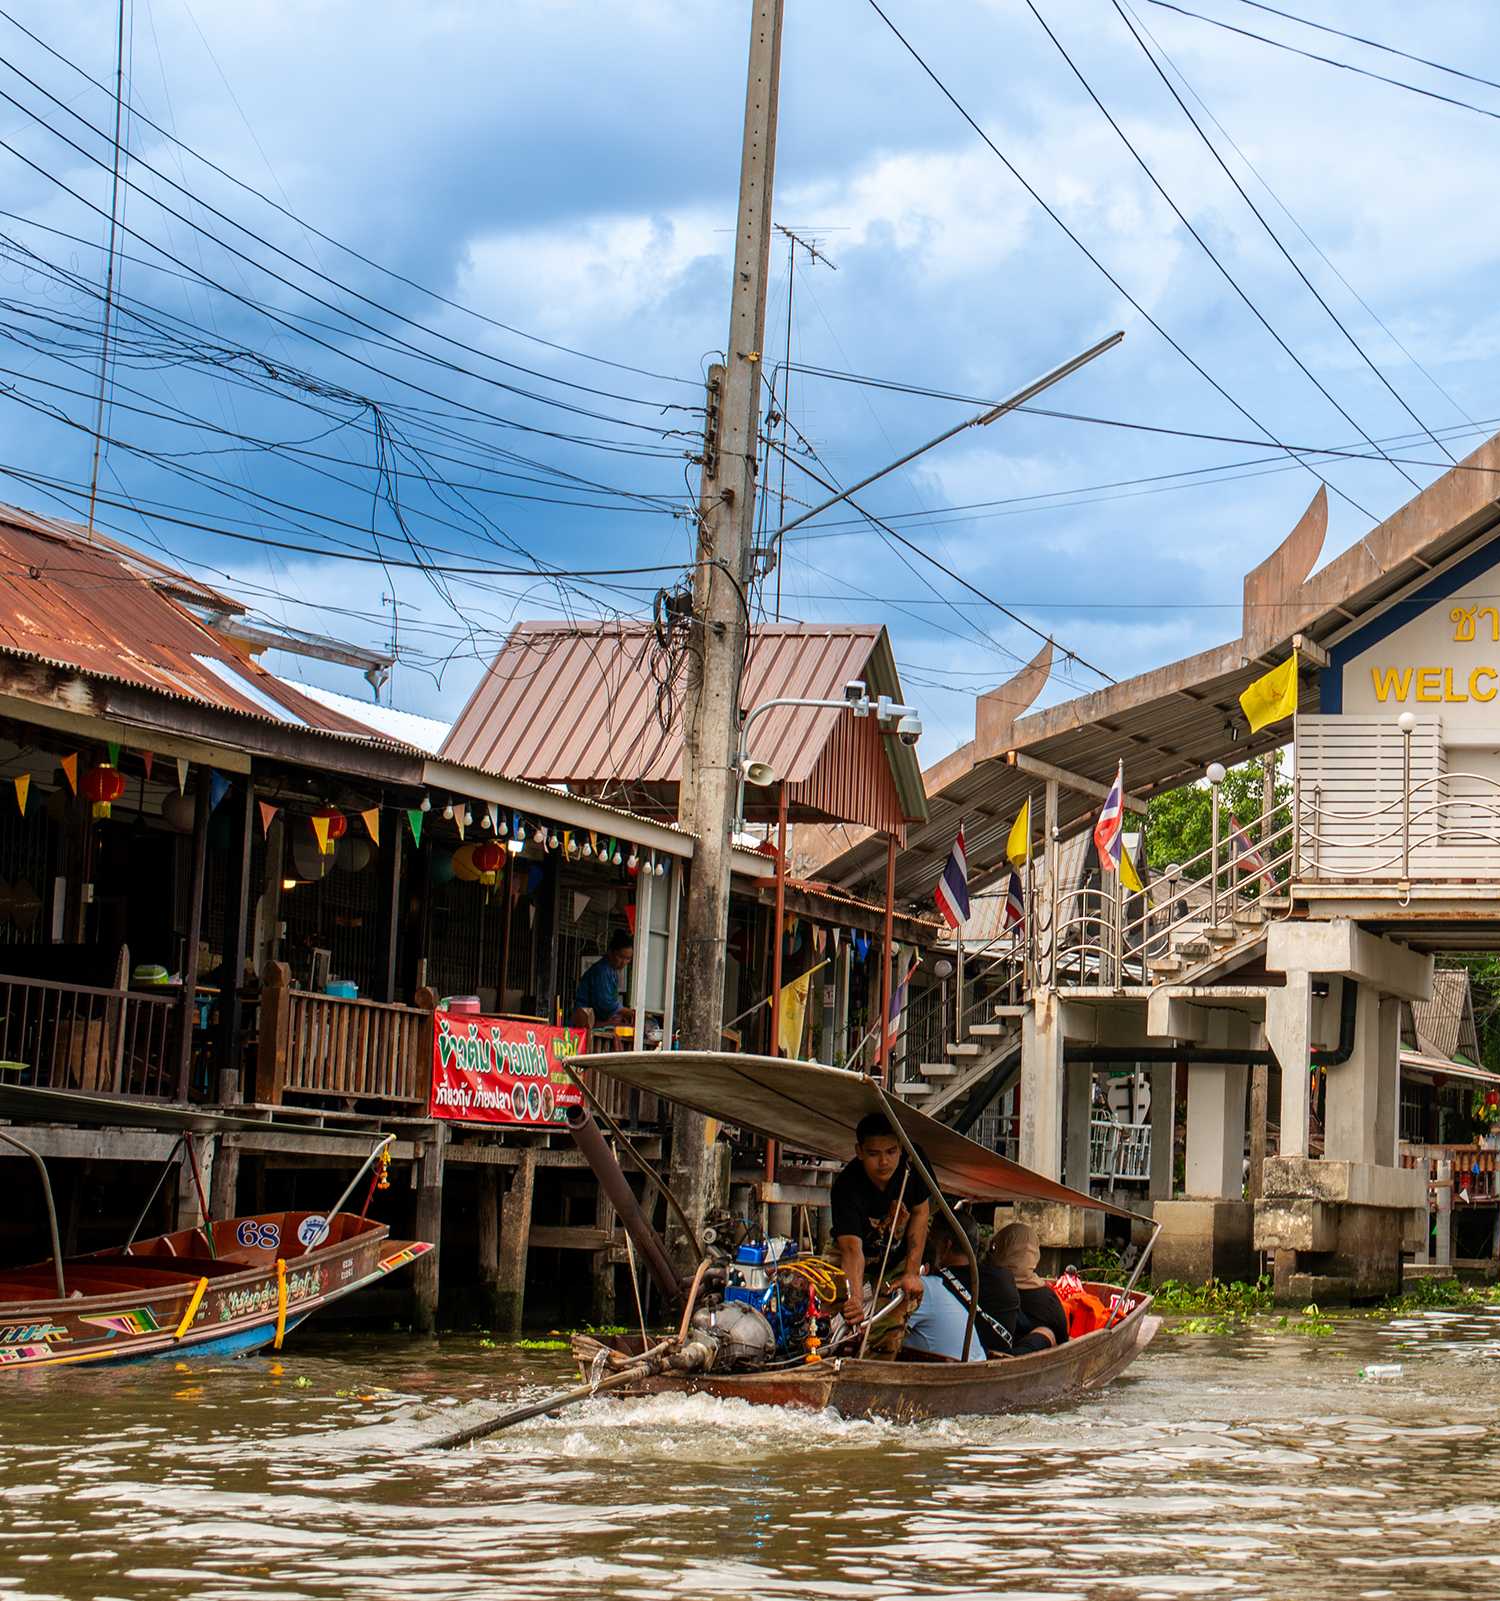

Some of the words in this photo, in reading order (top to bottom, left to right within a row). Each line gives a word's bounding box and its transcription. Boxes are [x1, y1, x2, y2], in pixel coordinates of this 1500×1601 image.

[439, 1019, 491, 1073] ข้าวต้ม
[491, 1026, 549, 1078] ข้าวแห้ง
[236, 1219, 281, 1250] 68
